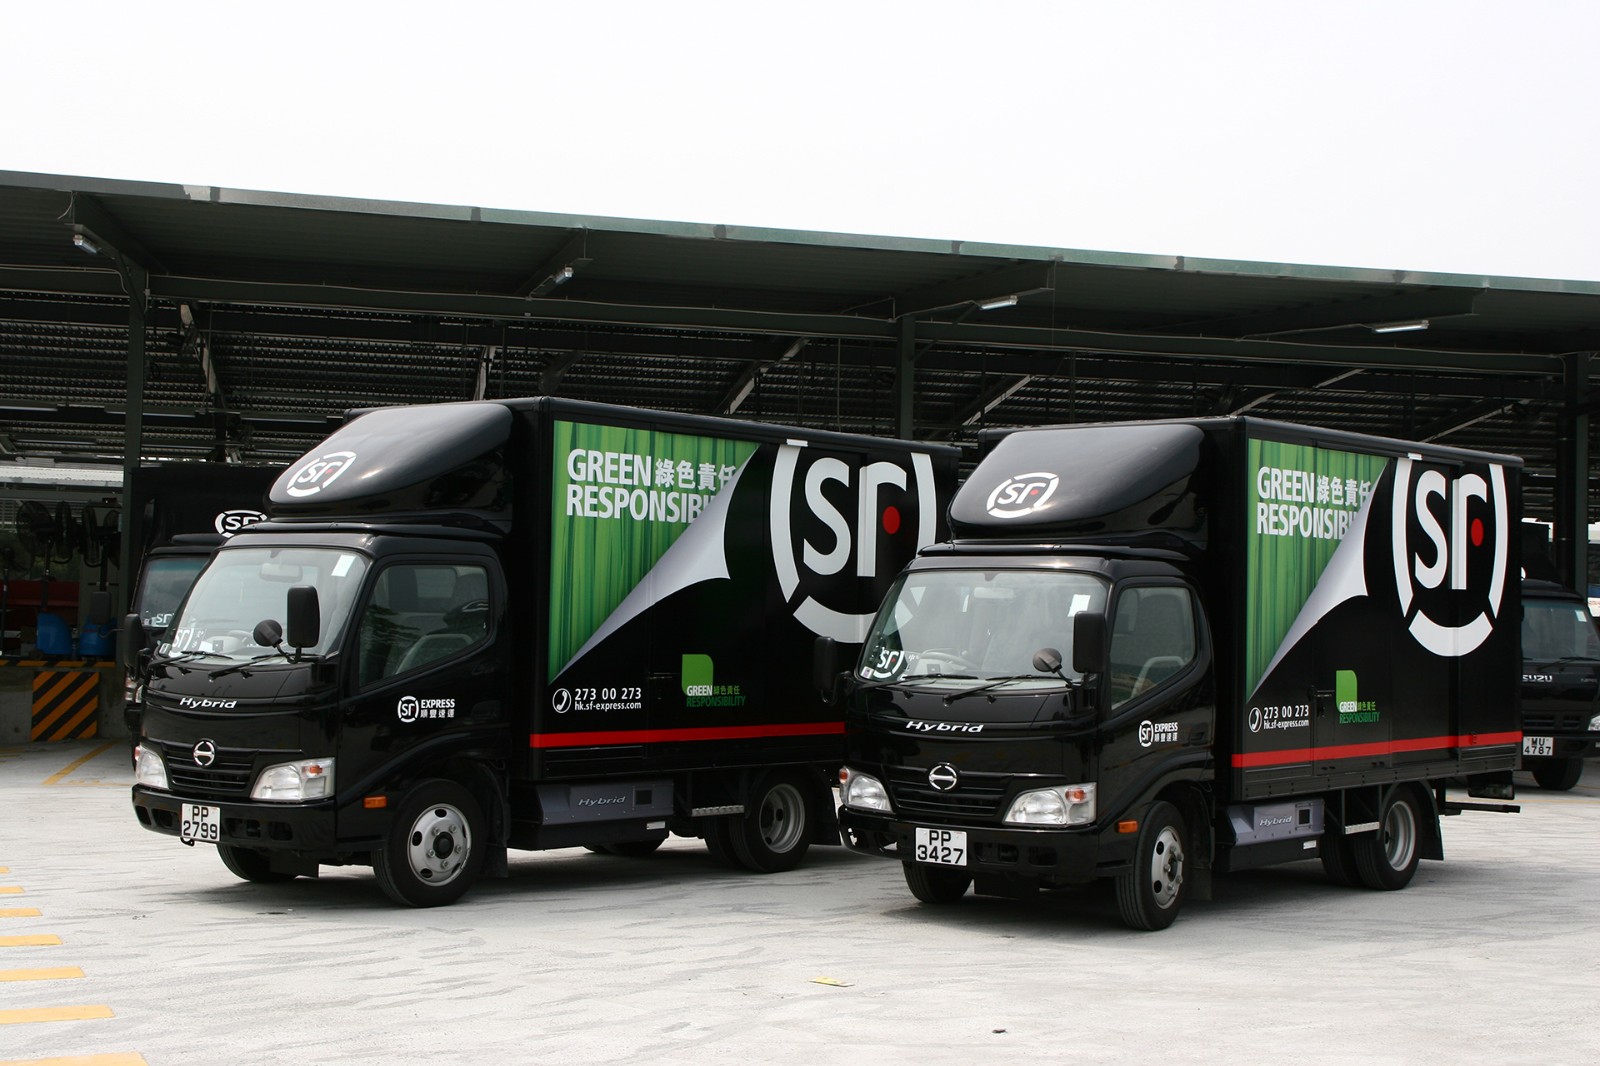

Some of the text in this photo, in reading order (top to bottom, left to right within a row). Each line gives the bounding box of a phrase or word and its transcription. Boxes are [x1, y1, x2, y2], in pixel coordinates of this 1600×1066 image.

[567, 448, 651, 487] GREEN
[1257, 466, 1315, 503] GREEN
[566, 484, 716, 525] RESPONSIB
[1256, 502, 1358, 540] RESPONSIB
[1522, 674, 1553, 683] SUZU
[574, 687, 642, 701] 273 00 273
[686, 685, 713, 697] GREEN
[179, 697, 238, 709] Hybrid
[420, 698, 456, 709] EXPRESS
[574, 700, 642, 712] hk.sf-express.com
[686, 696, 747, 708] RESPONSIBILITY
[1263, 704, 1310, 720] 273 00 273
[905, 720, 985, 733] Hybrid
[1154, 721, 1179, 733] EXPRESS
[1263, 718, 1310, 730] hk.sf-express.com
[1524, 746, 1552, 755] 4787
[578, 796, 626, 807] Hybrid
[192, 805, 209, 822] PP
[1259, 815, 1293, 827] Hybrid
[183, 820, 218, 840] 2799
[929, 830, 952, 847] PP
[917, 844, 964, 865] 3427
